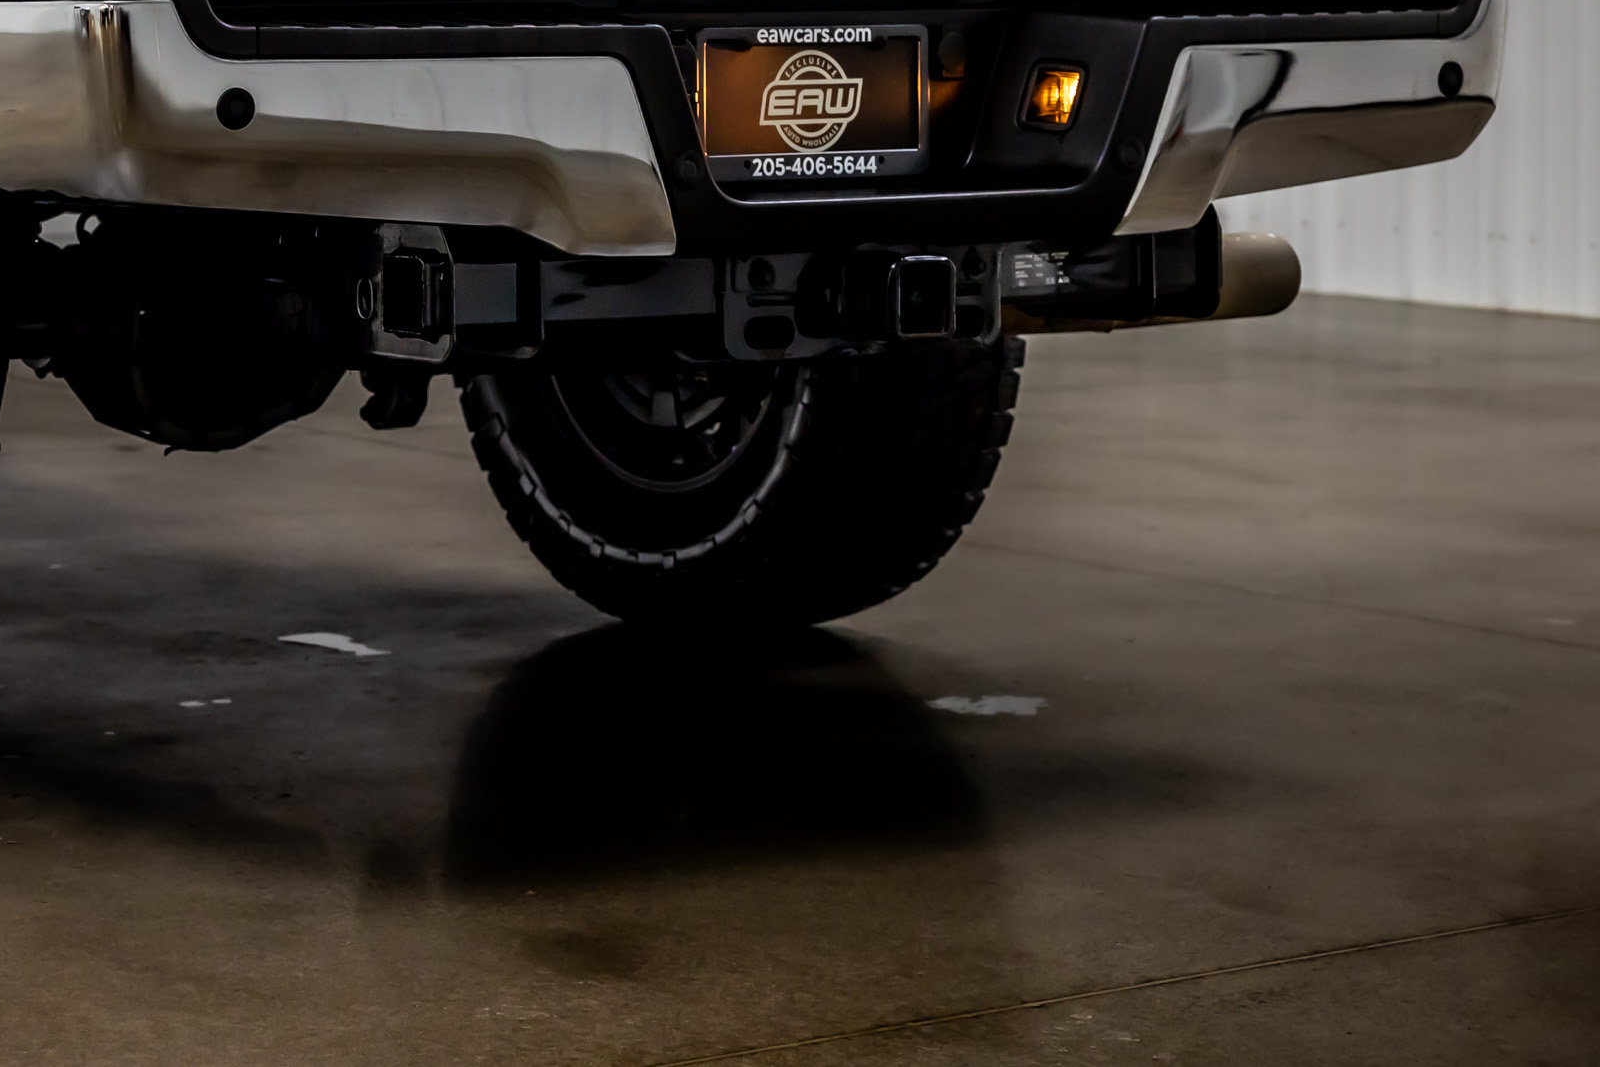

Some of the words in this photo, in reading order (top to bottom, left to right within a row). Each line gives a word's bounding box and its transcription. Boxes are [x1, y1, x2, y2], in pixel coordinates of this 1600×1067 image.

[756, 27, 872, 44] eawcars.com
[785, 56, 837, 78] EXCLUSIVE
[768, 87, 854, 116] EAW
[783, 125, 801, 146] AUTO
[801, 123, 840, 147] WHOLESALE
[752, 155, 878, 177] 205-406-5644
